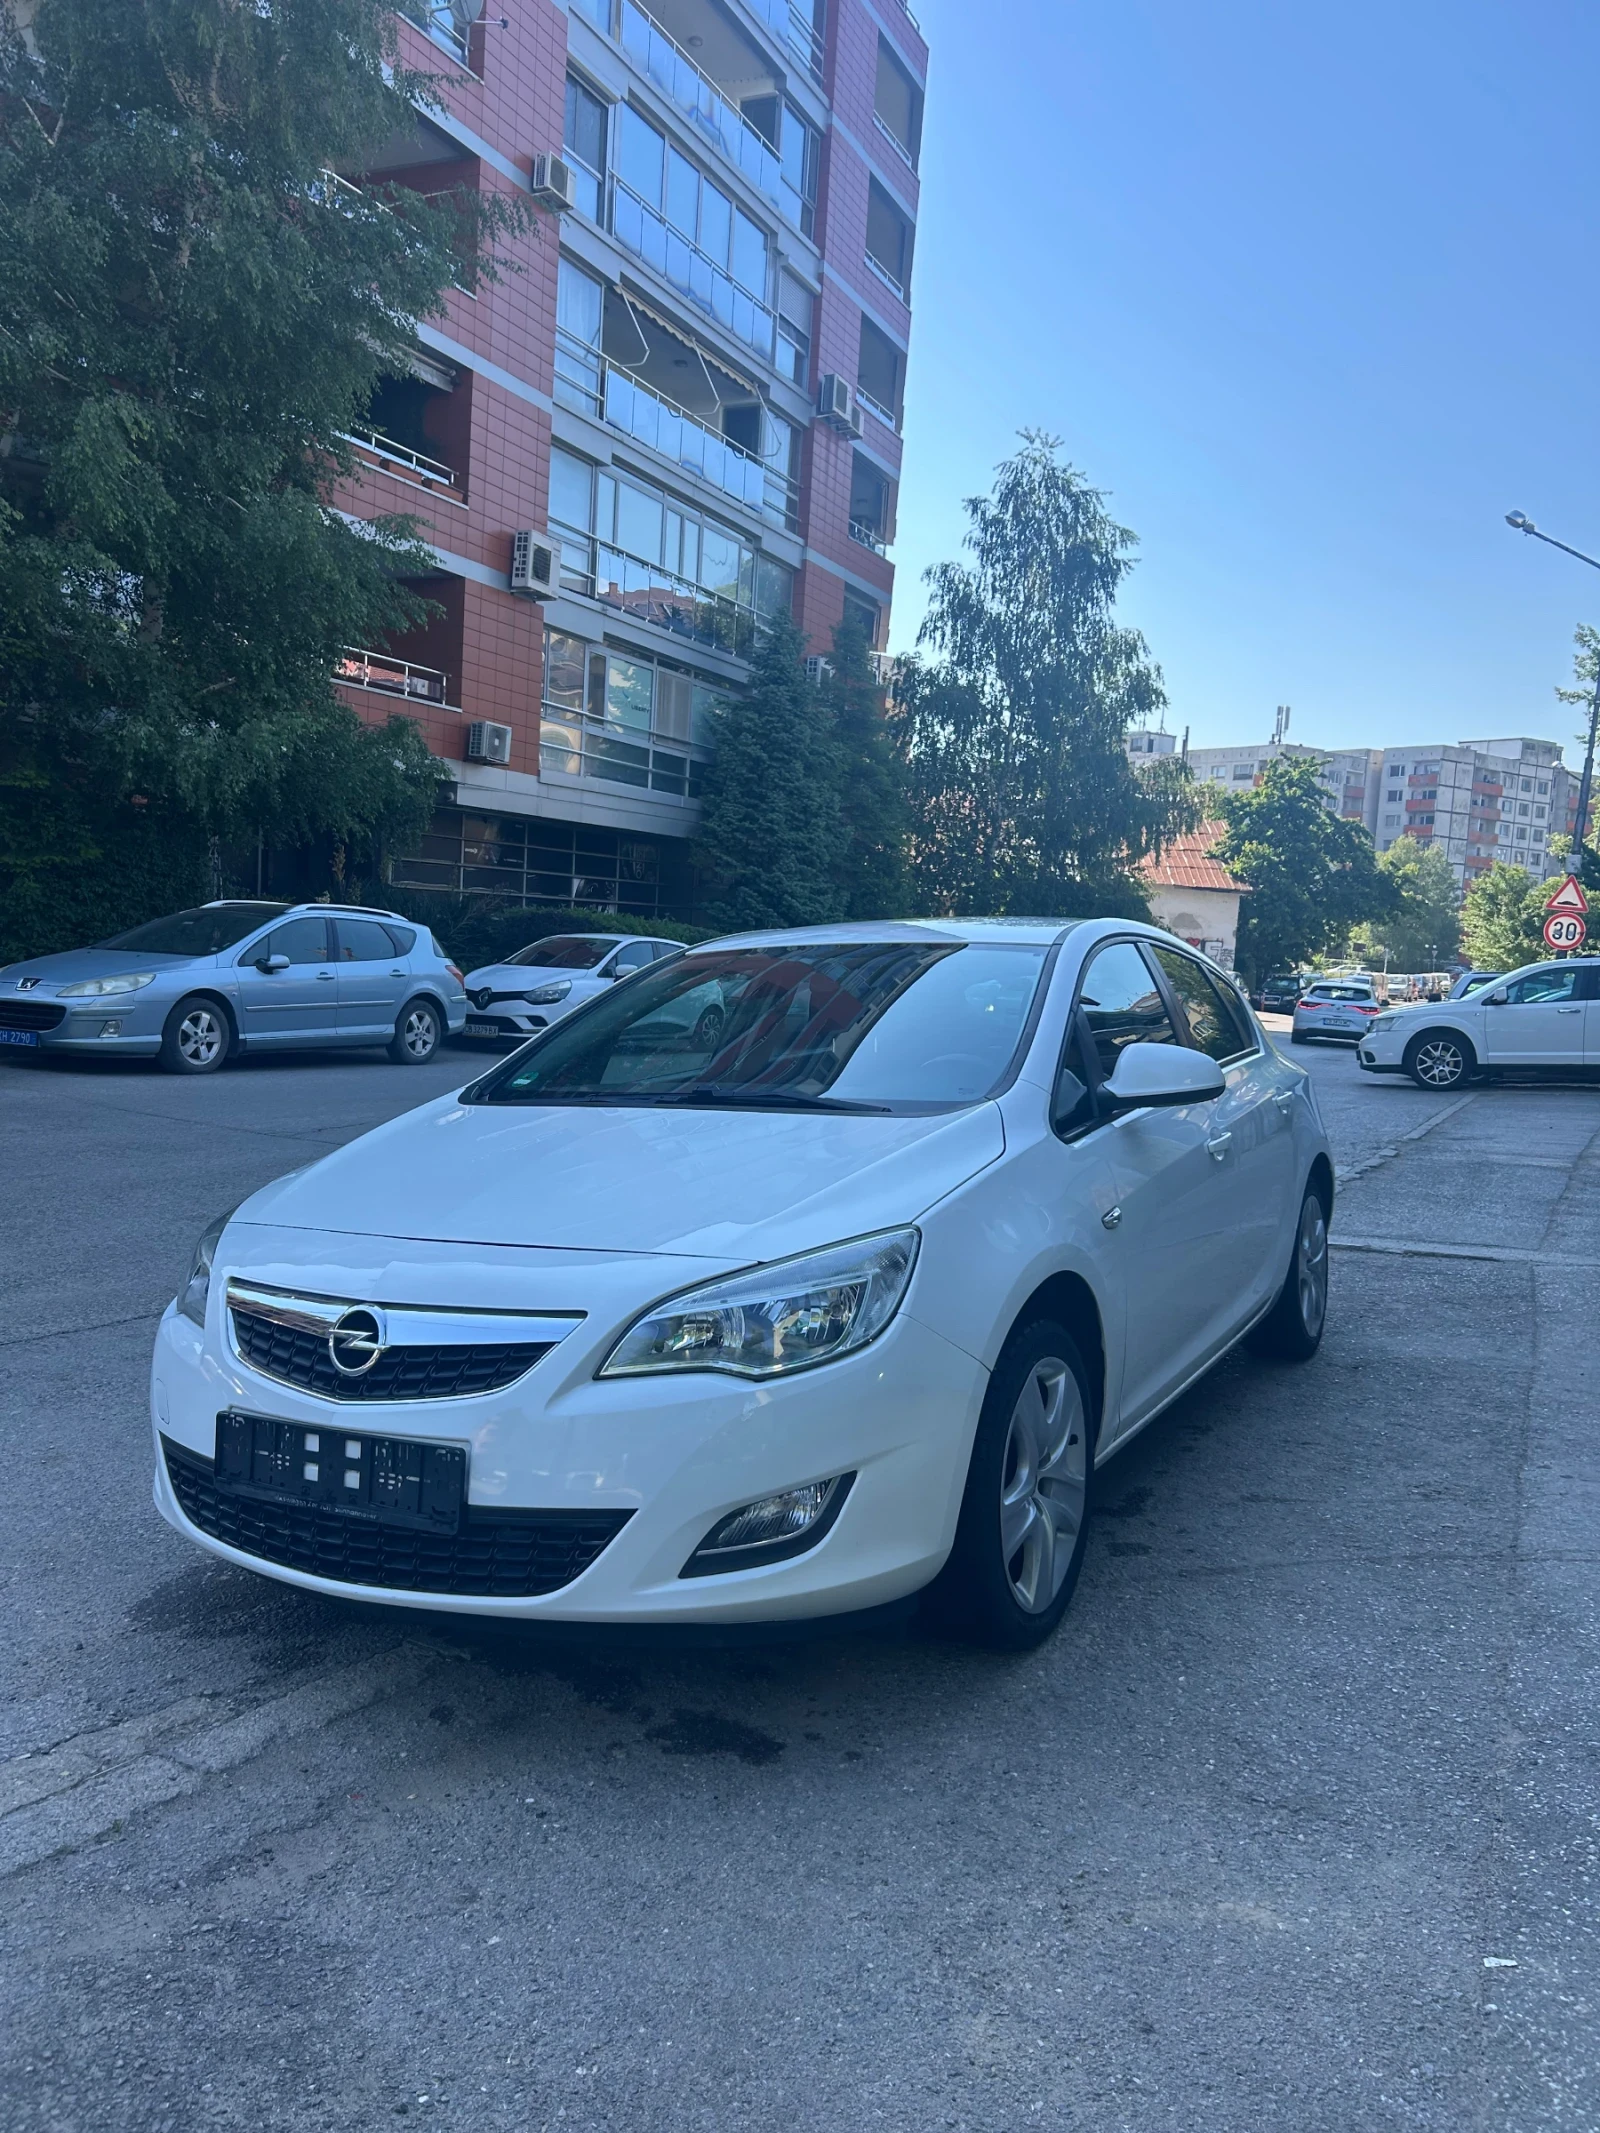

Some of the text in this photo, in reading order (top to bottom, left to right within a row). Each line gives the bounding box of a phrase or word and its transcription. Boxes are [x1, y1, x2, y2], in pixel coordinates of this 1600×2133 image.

[631, 705, 650, 714] LIBERTY
[1552, 921, 1577, 941] 30
[11, 1031, 31, 1043] 2790
